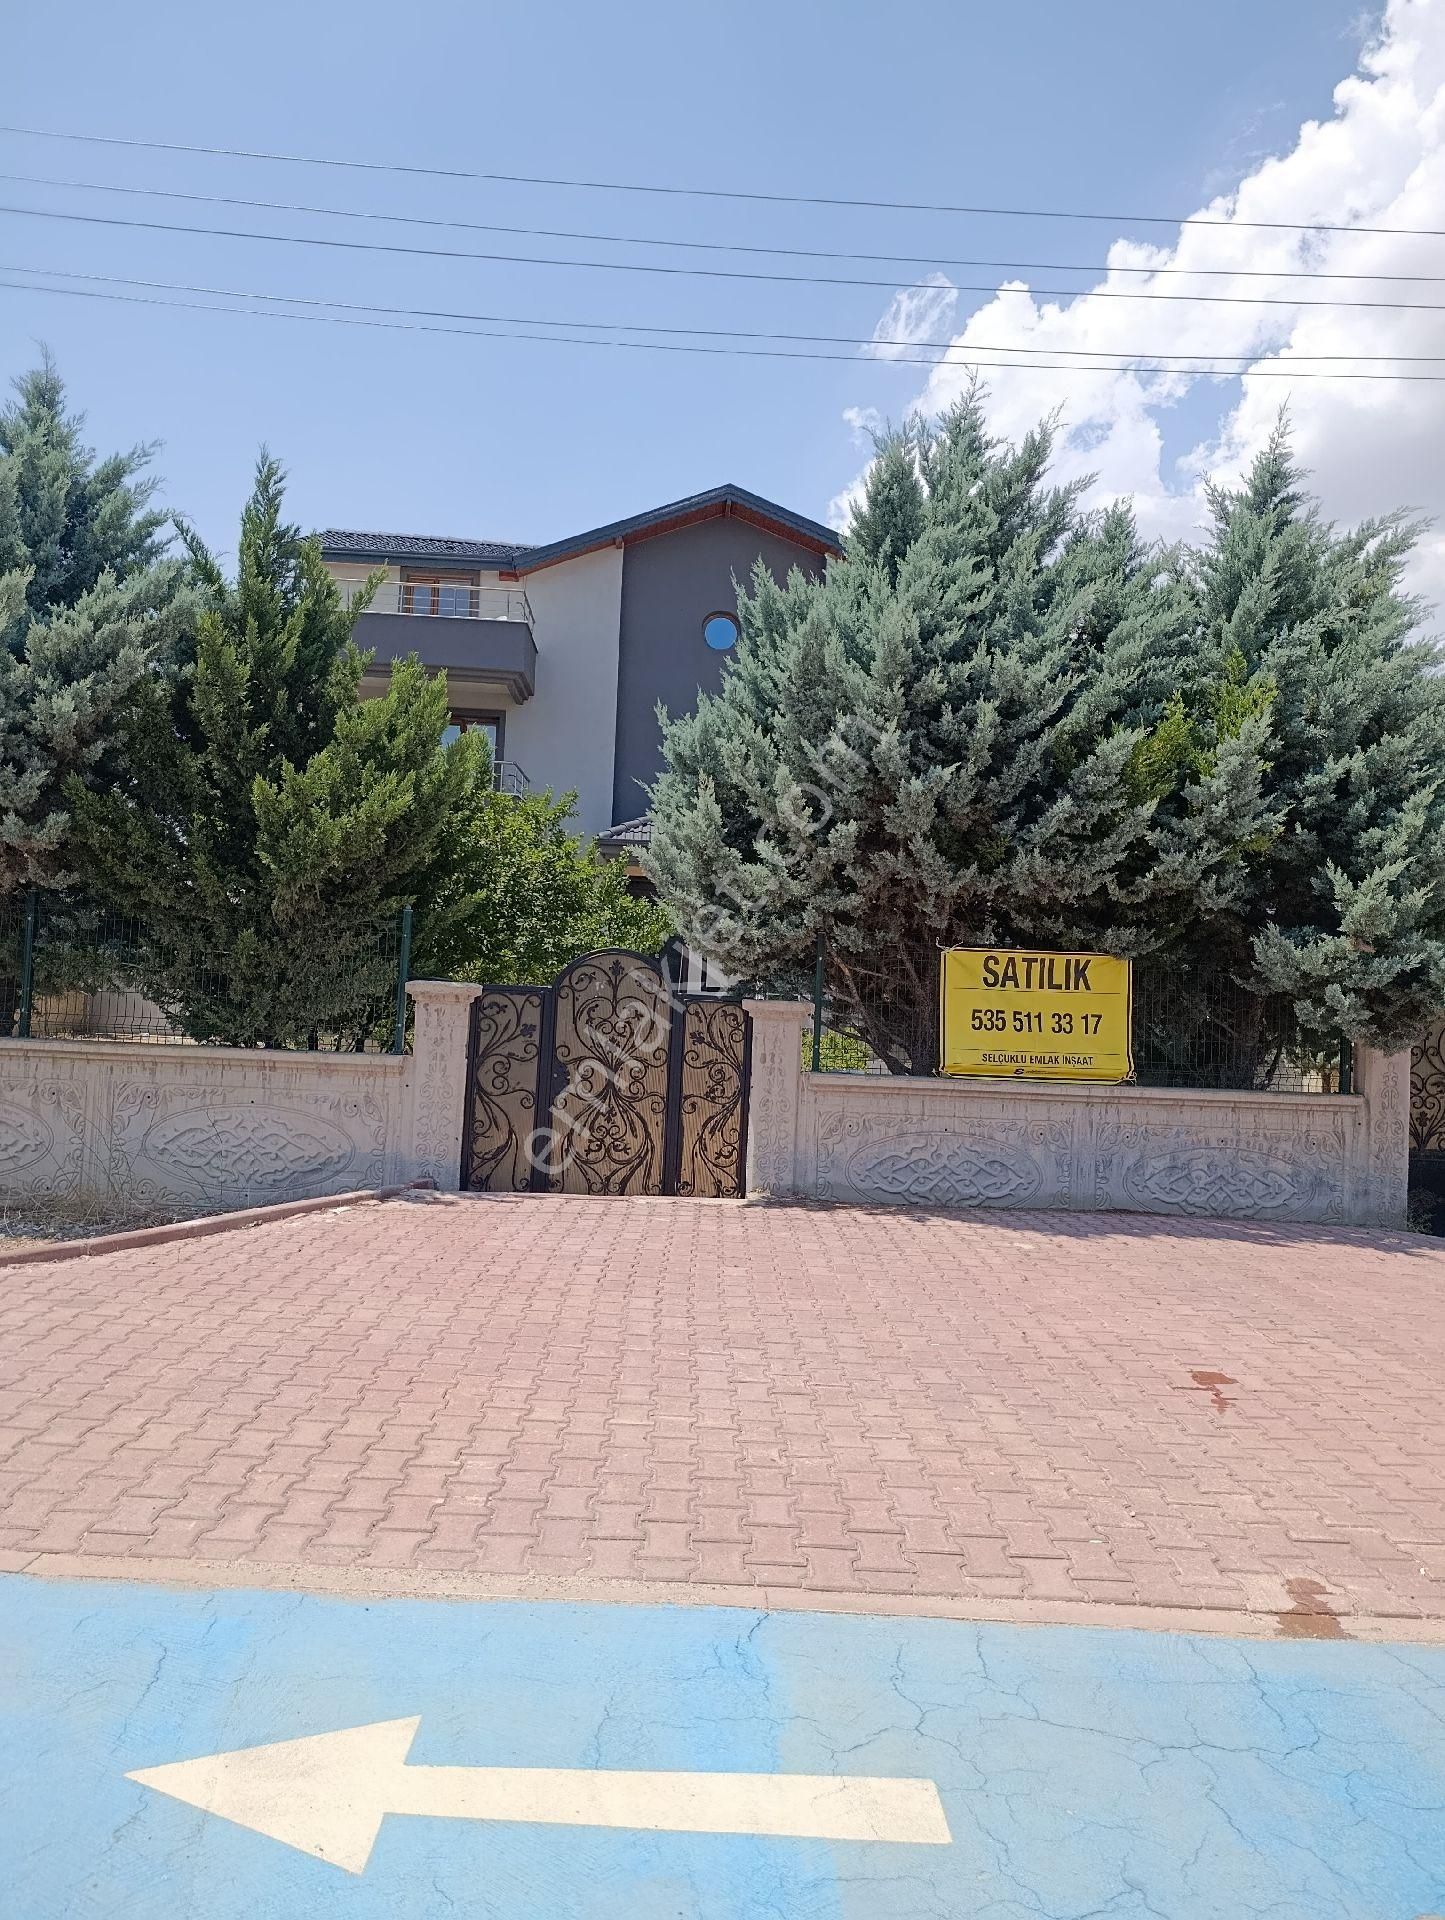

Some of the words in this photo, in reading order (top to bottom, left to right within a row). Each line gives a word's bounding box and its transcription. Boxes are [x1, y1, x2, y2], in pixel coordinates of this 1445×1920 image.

[982, 955, 1092, 991] SATILIK
[971, 1009, 1007, 1031] 535
[1012, 1010, 1043, 1033] 511
[1051, 1012, 1074, 1035] 33
[1080, 1013, 1103, 1035] 17
[981, 1053, 1027, 1065] SELÇUKLU
[1029, 1055, 1060, 1065] EMLAK
[1062, 1054, 1094, 1067] İNŞAAT
